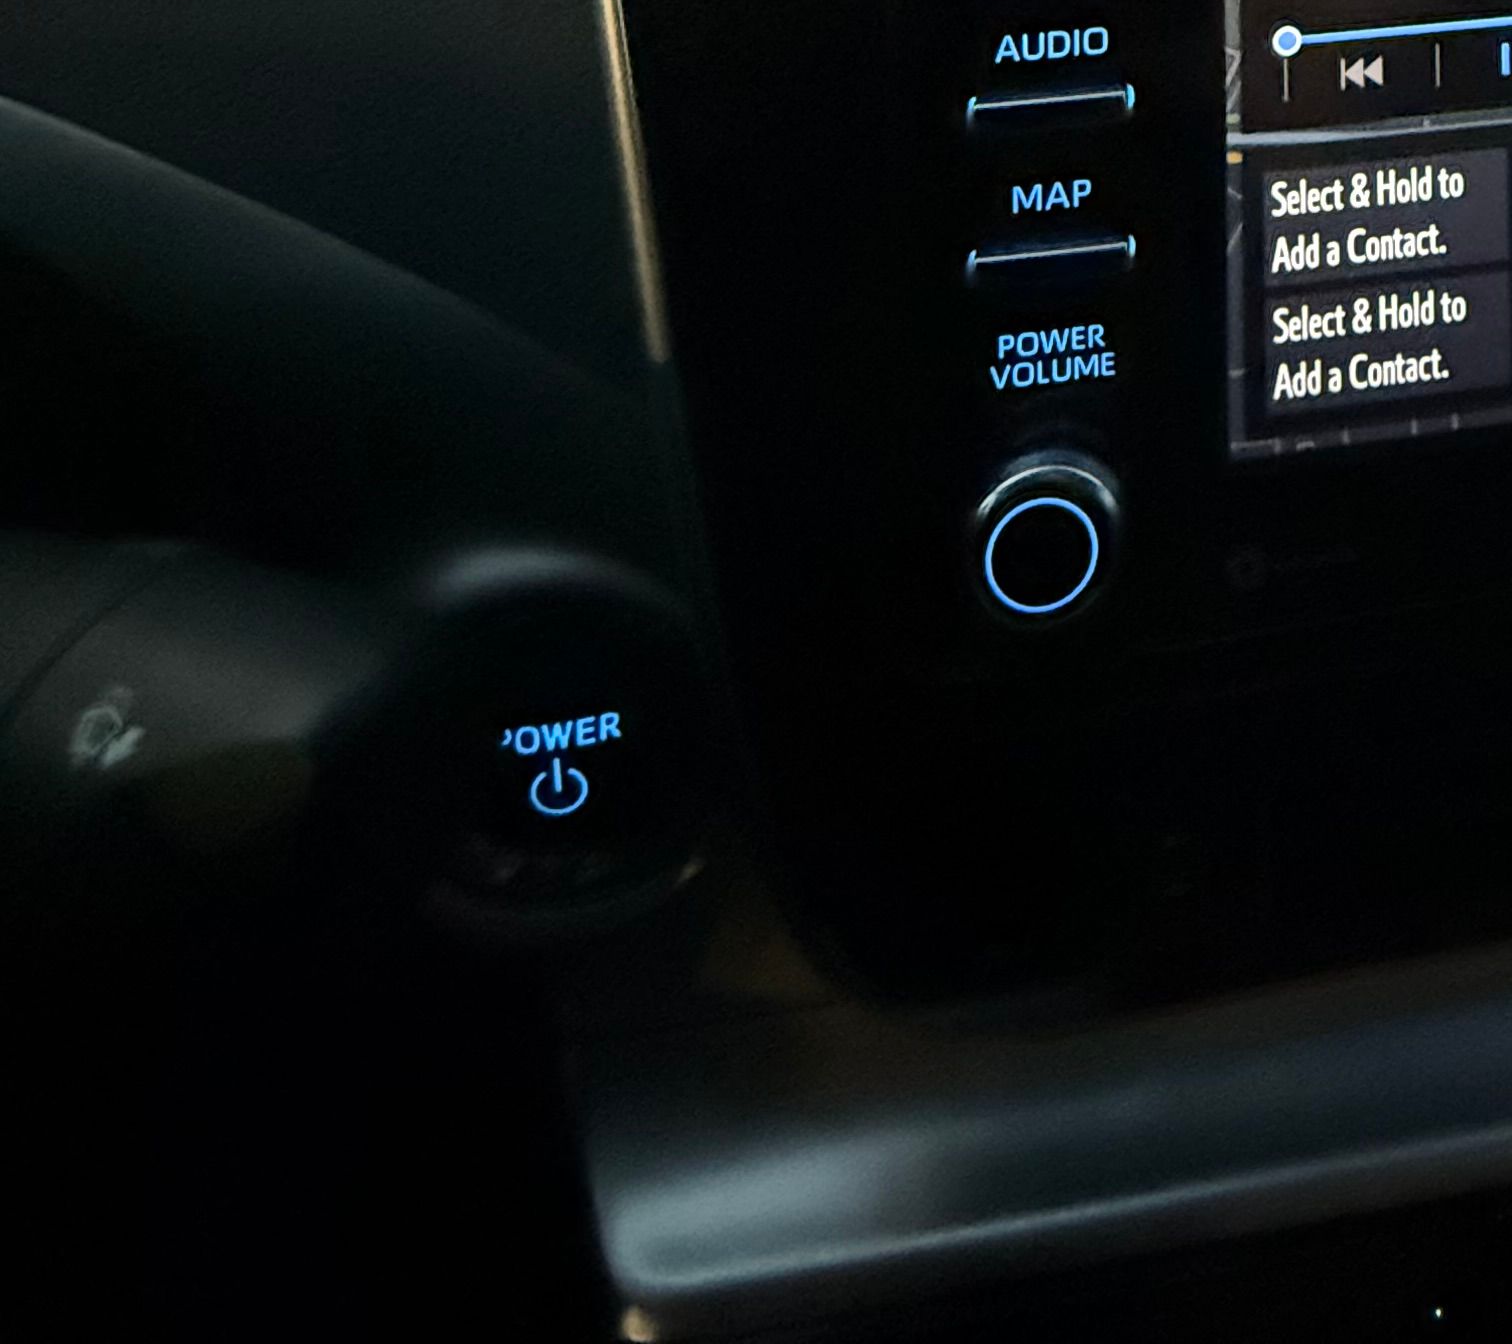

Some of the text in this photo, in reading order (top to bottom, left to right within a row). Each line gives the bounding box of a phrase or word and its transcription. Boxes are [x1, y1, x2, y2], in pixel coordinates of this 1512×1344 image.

[994, 26, 1109, 64] AUDIO
[1011, 180, 1092, 214] MAP
[1271, 165, 1464, 218] Select & Hold to
[1271, 223, 1447, 274] Add a Contact.
[1273, 289, 1467, 344] Select & Hold to
[998, 324, 1106, 360] POWER
[990, 351, 1116, 390] VOLUME
[1273, 348, 1450, 400] Add a Contact.
